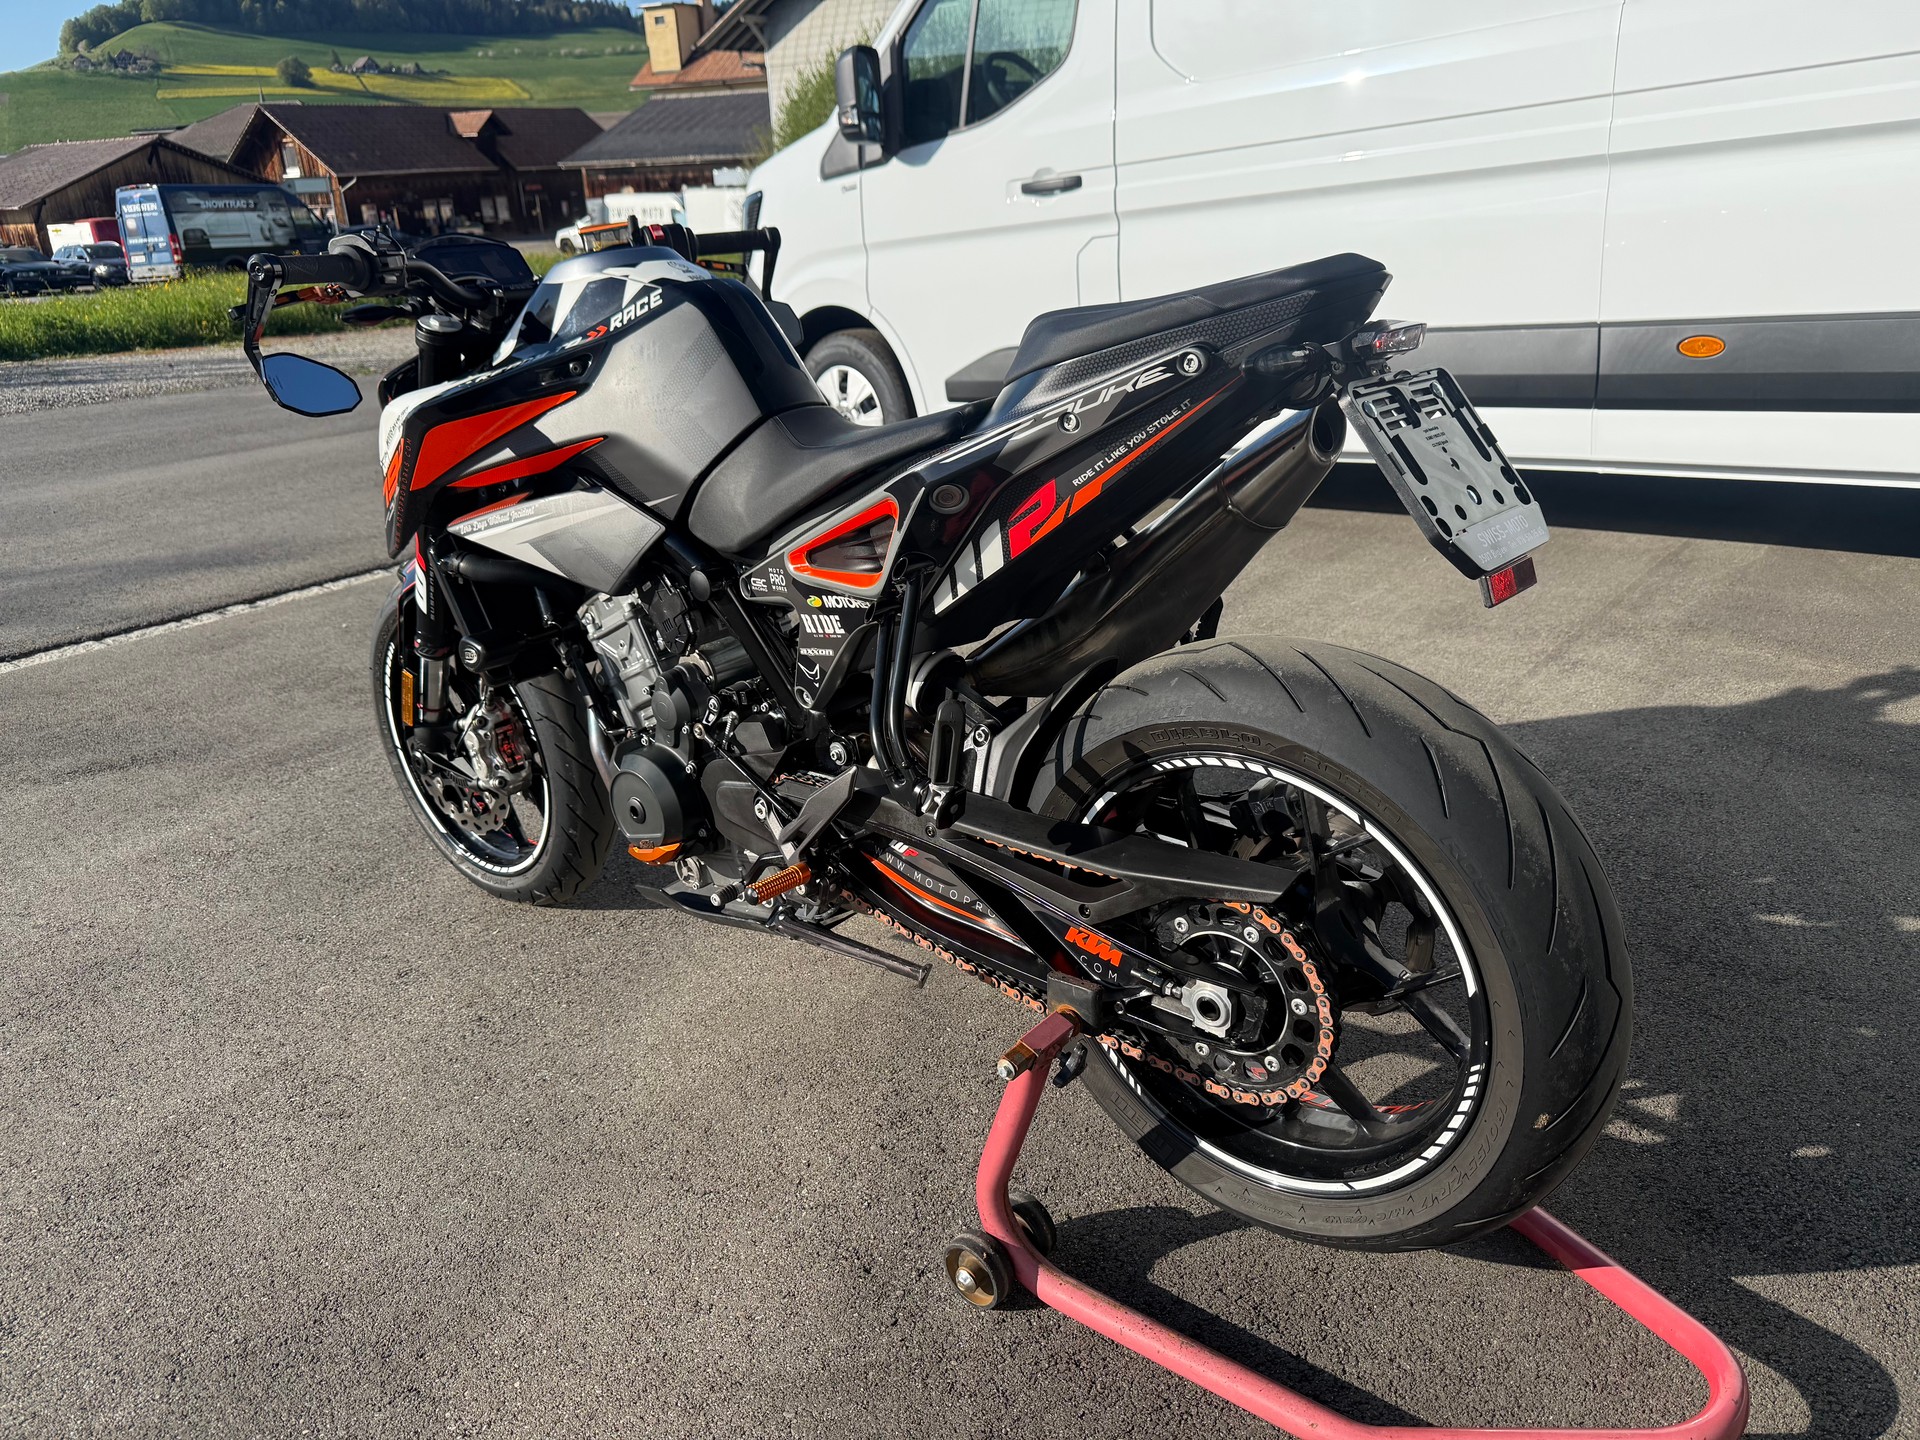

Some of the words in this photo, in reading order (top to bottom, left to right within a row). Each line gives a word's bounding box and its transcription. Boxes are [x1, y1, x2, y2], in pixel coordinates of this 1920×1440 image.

[200, 200, 247, 209] SNOWTRAC
[248, 200, 255, 208] 3
[609, 288, 663, 332] RACE
[1072, 468, 1096, 486] RIDE
[1094, 460, 1105, 472] IT
[1105, 444, 1129, 464] LIKE
[1127, 431, 1147, 448] YOU
[1146, 407, 1181, 434] STOLE
[1180, 398, 1192, 410] IT
[1477, 514, 1529, 547] SWISS-MOTO
[769, 572, 786, 586] PRO
[771, 584, 788, 592] WORKS
[800, 614, 846, 634] RIDE
[800, 647, 835, 657] axxon
[1150, 726, 1262, 748] DIABLO
[1064, 926, 1123, 967] KTM
[1080, 955, 1118, 983] COM
